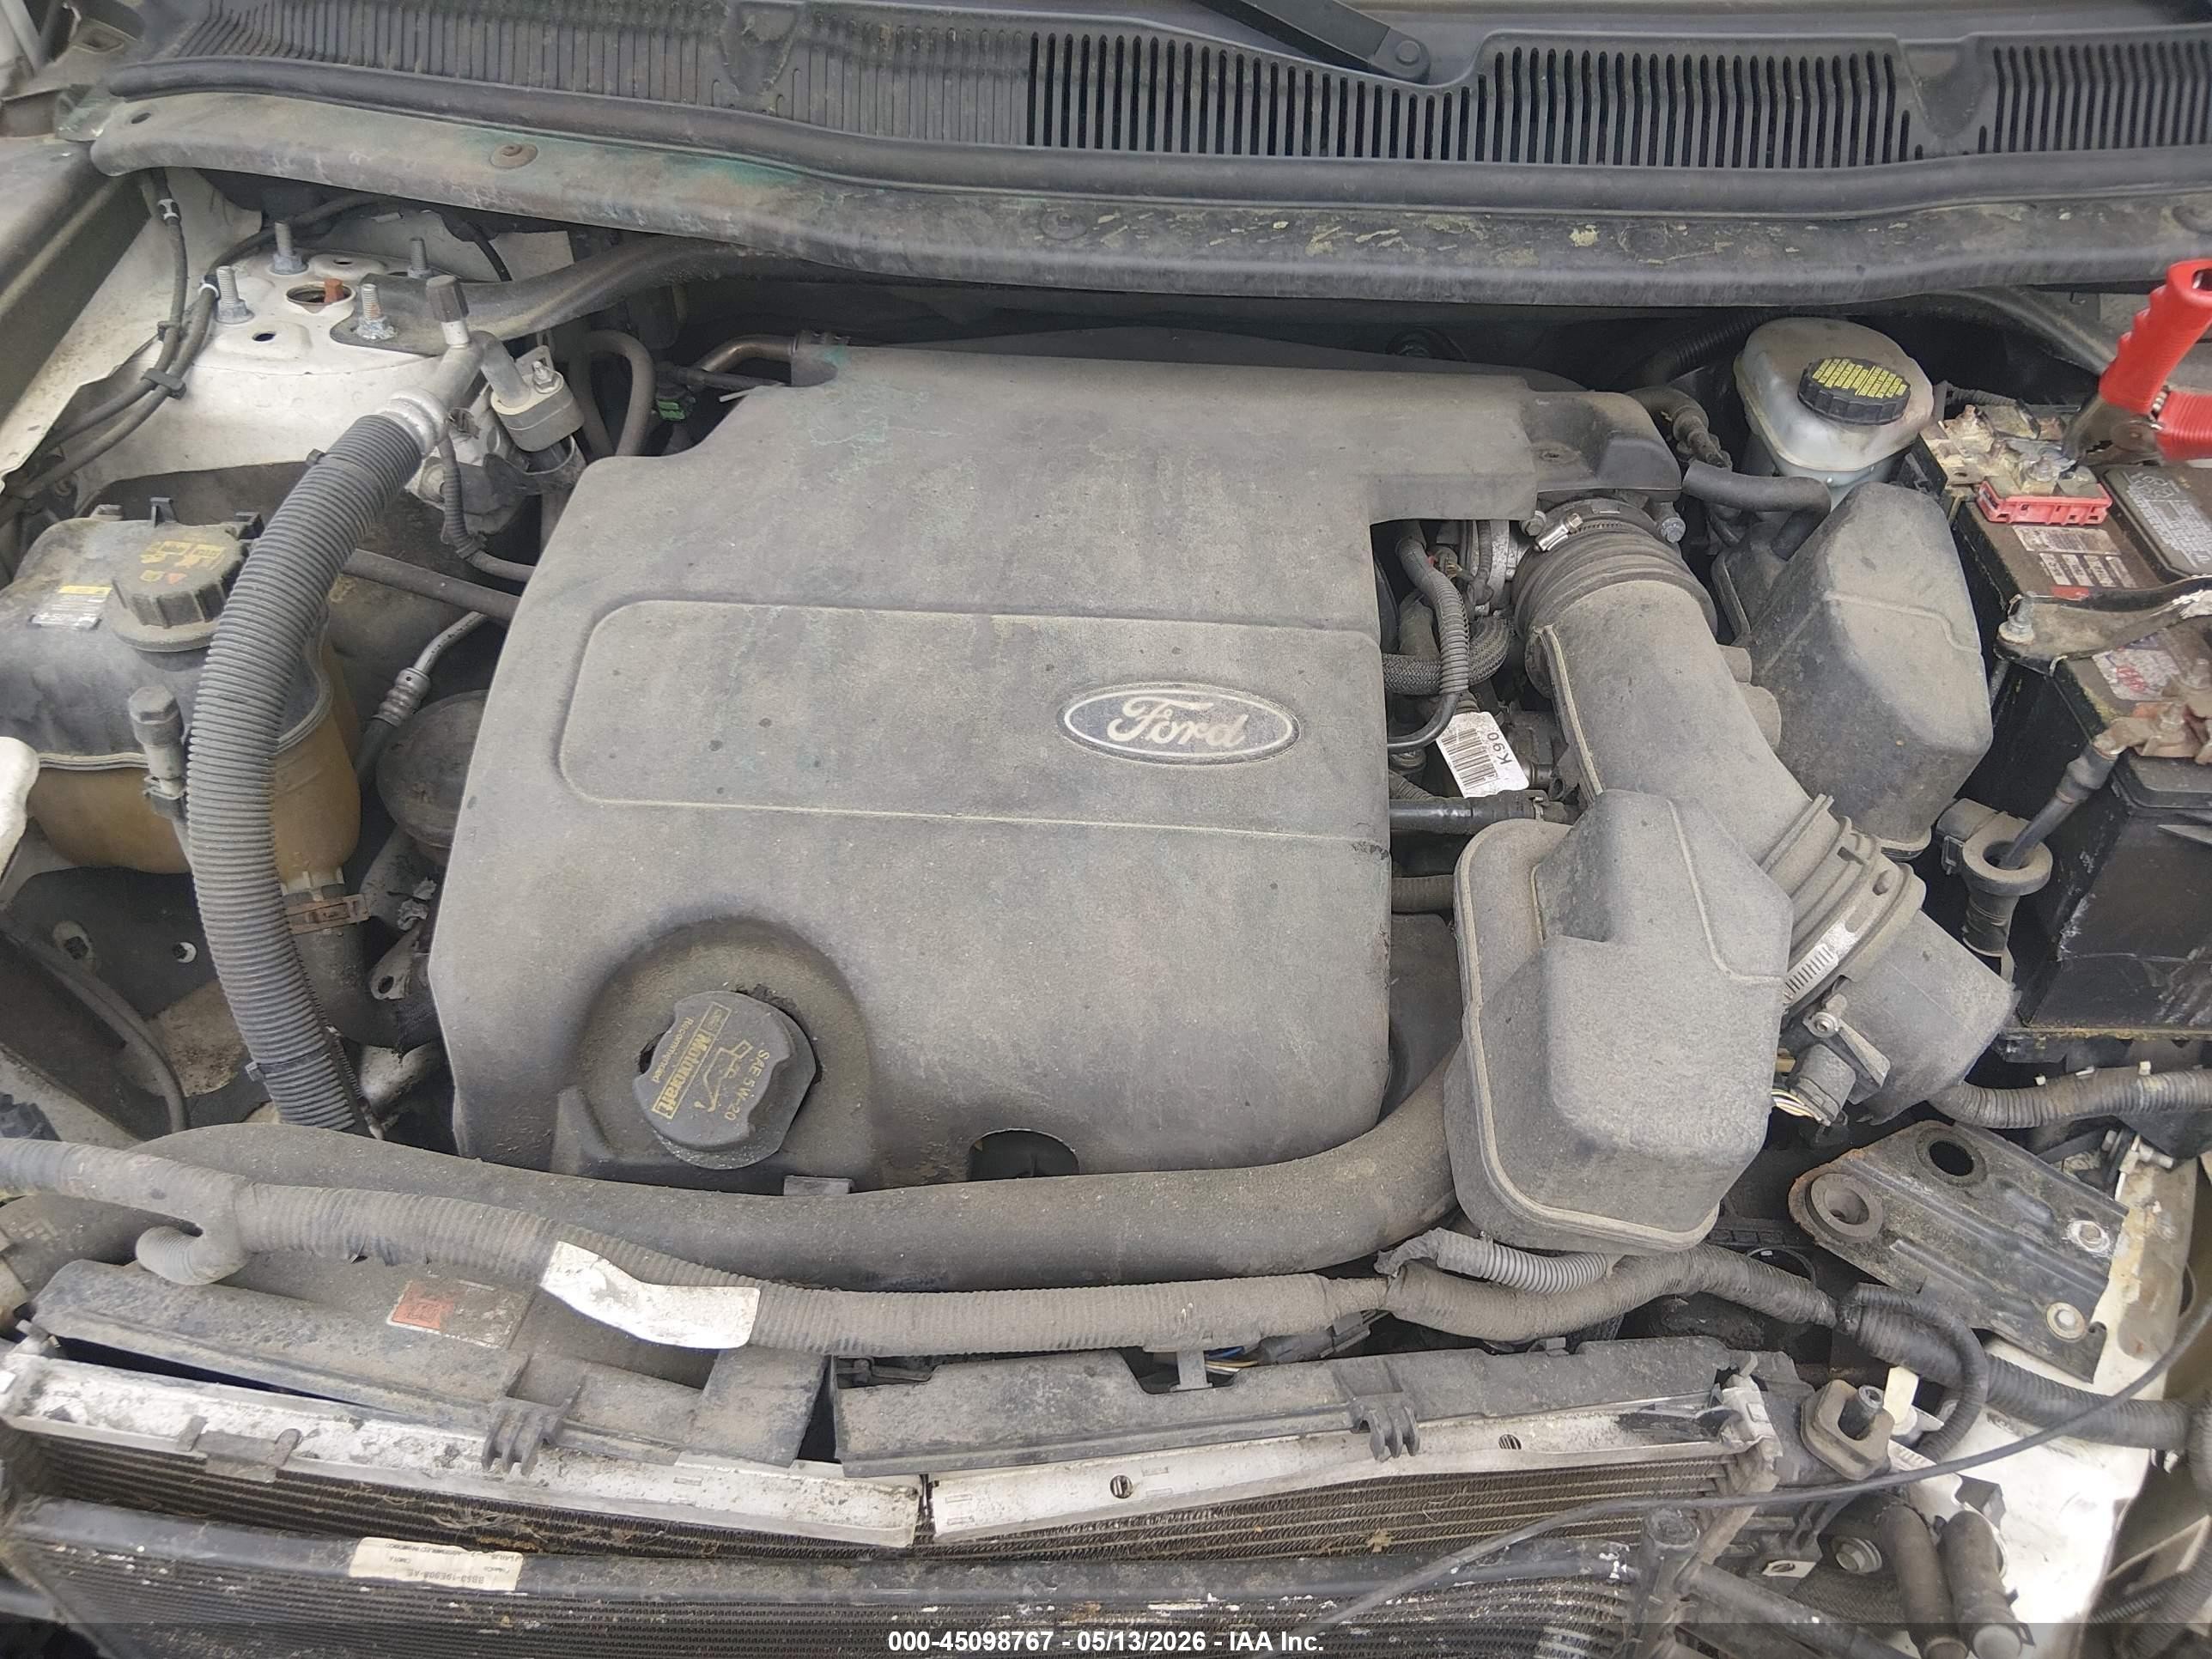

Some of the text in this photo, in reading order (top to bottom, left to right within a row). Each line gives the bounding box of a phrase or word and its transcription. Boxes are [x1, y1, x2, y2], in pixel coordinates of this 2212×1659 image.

[1107, 696, 1249, 748] Ford
[1486, 732, 1513, 765] K90
[651, 1017, 695, 1084] Recommended
[657, 1033, 712, 1111] Motorcraft
[749, 1049, 770, 1077] SAE
